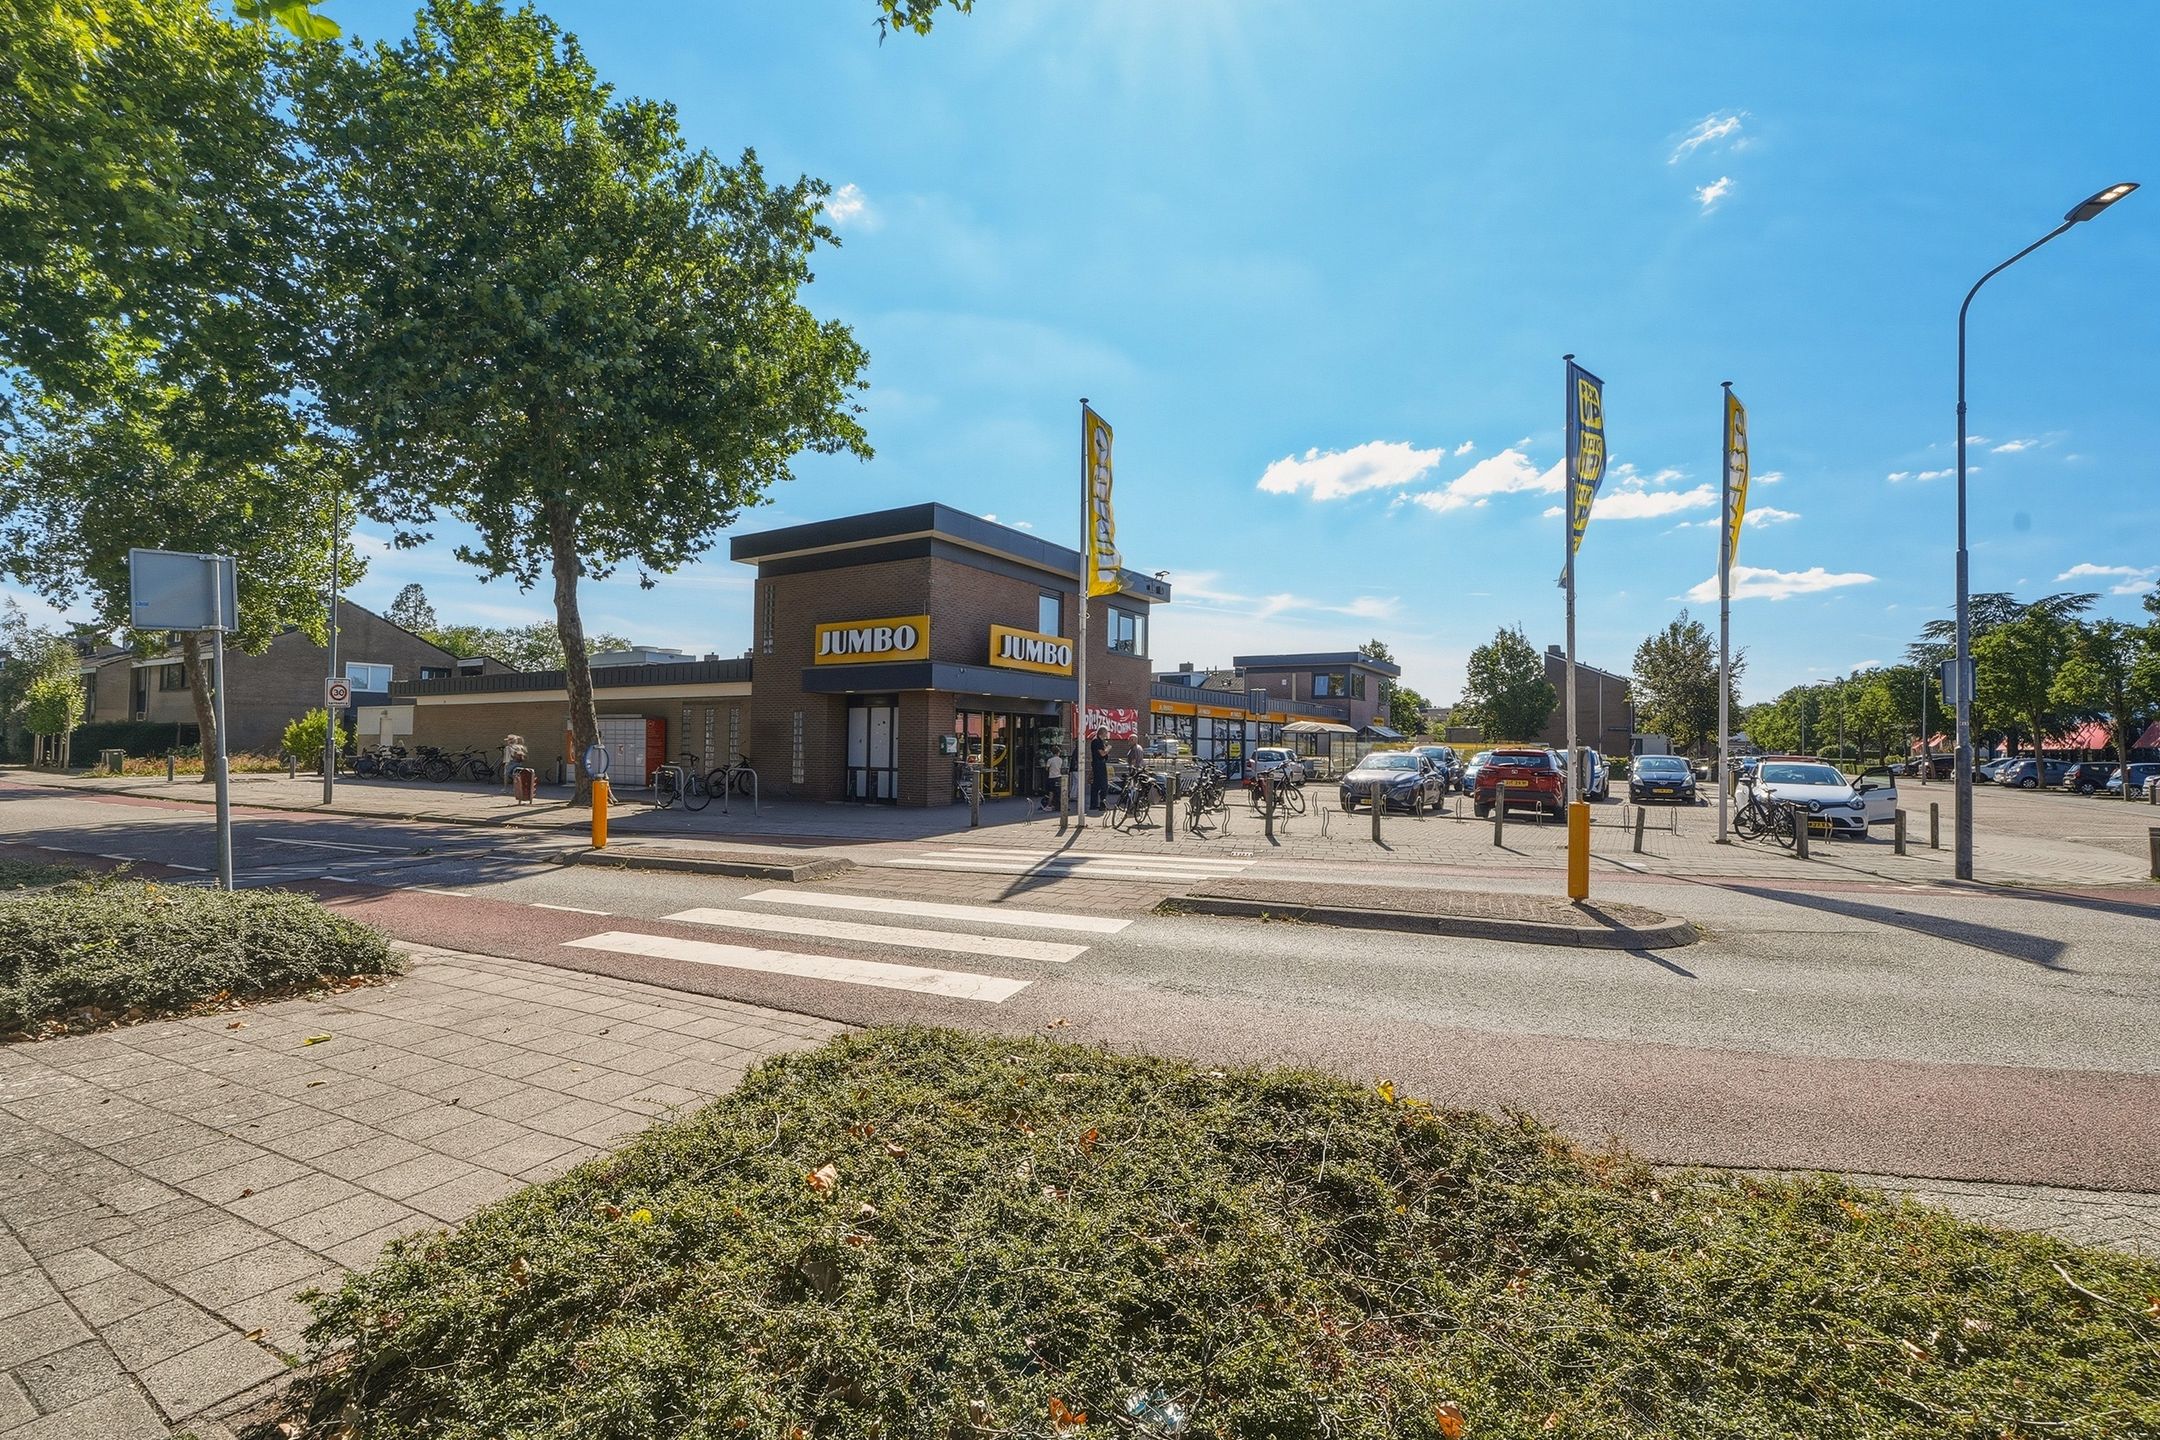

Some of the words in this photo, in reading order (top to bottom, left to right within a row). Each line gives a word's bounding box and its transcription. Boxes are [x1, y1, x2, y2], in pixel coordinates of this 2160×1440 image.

[1583, 397, 1600, 420] UP
[818, 625, 916, 655] JUMBO
[1001, 635, 1072, 667] JUMBO
